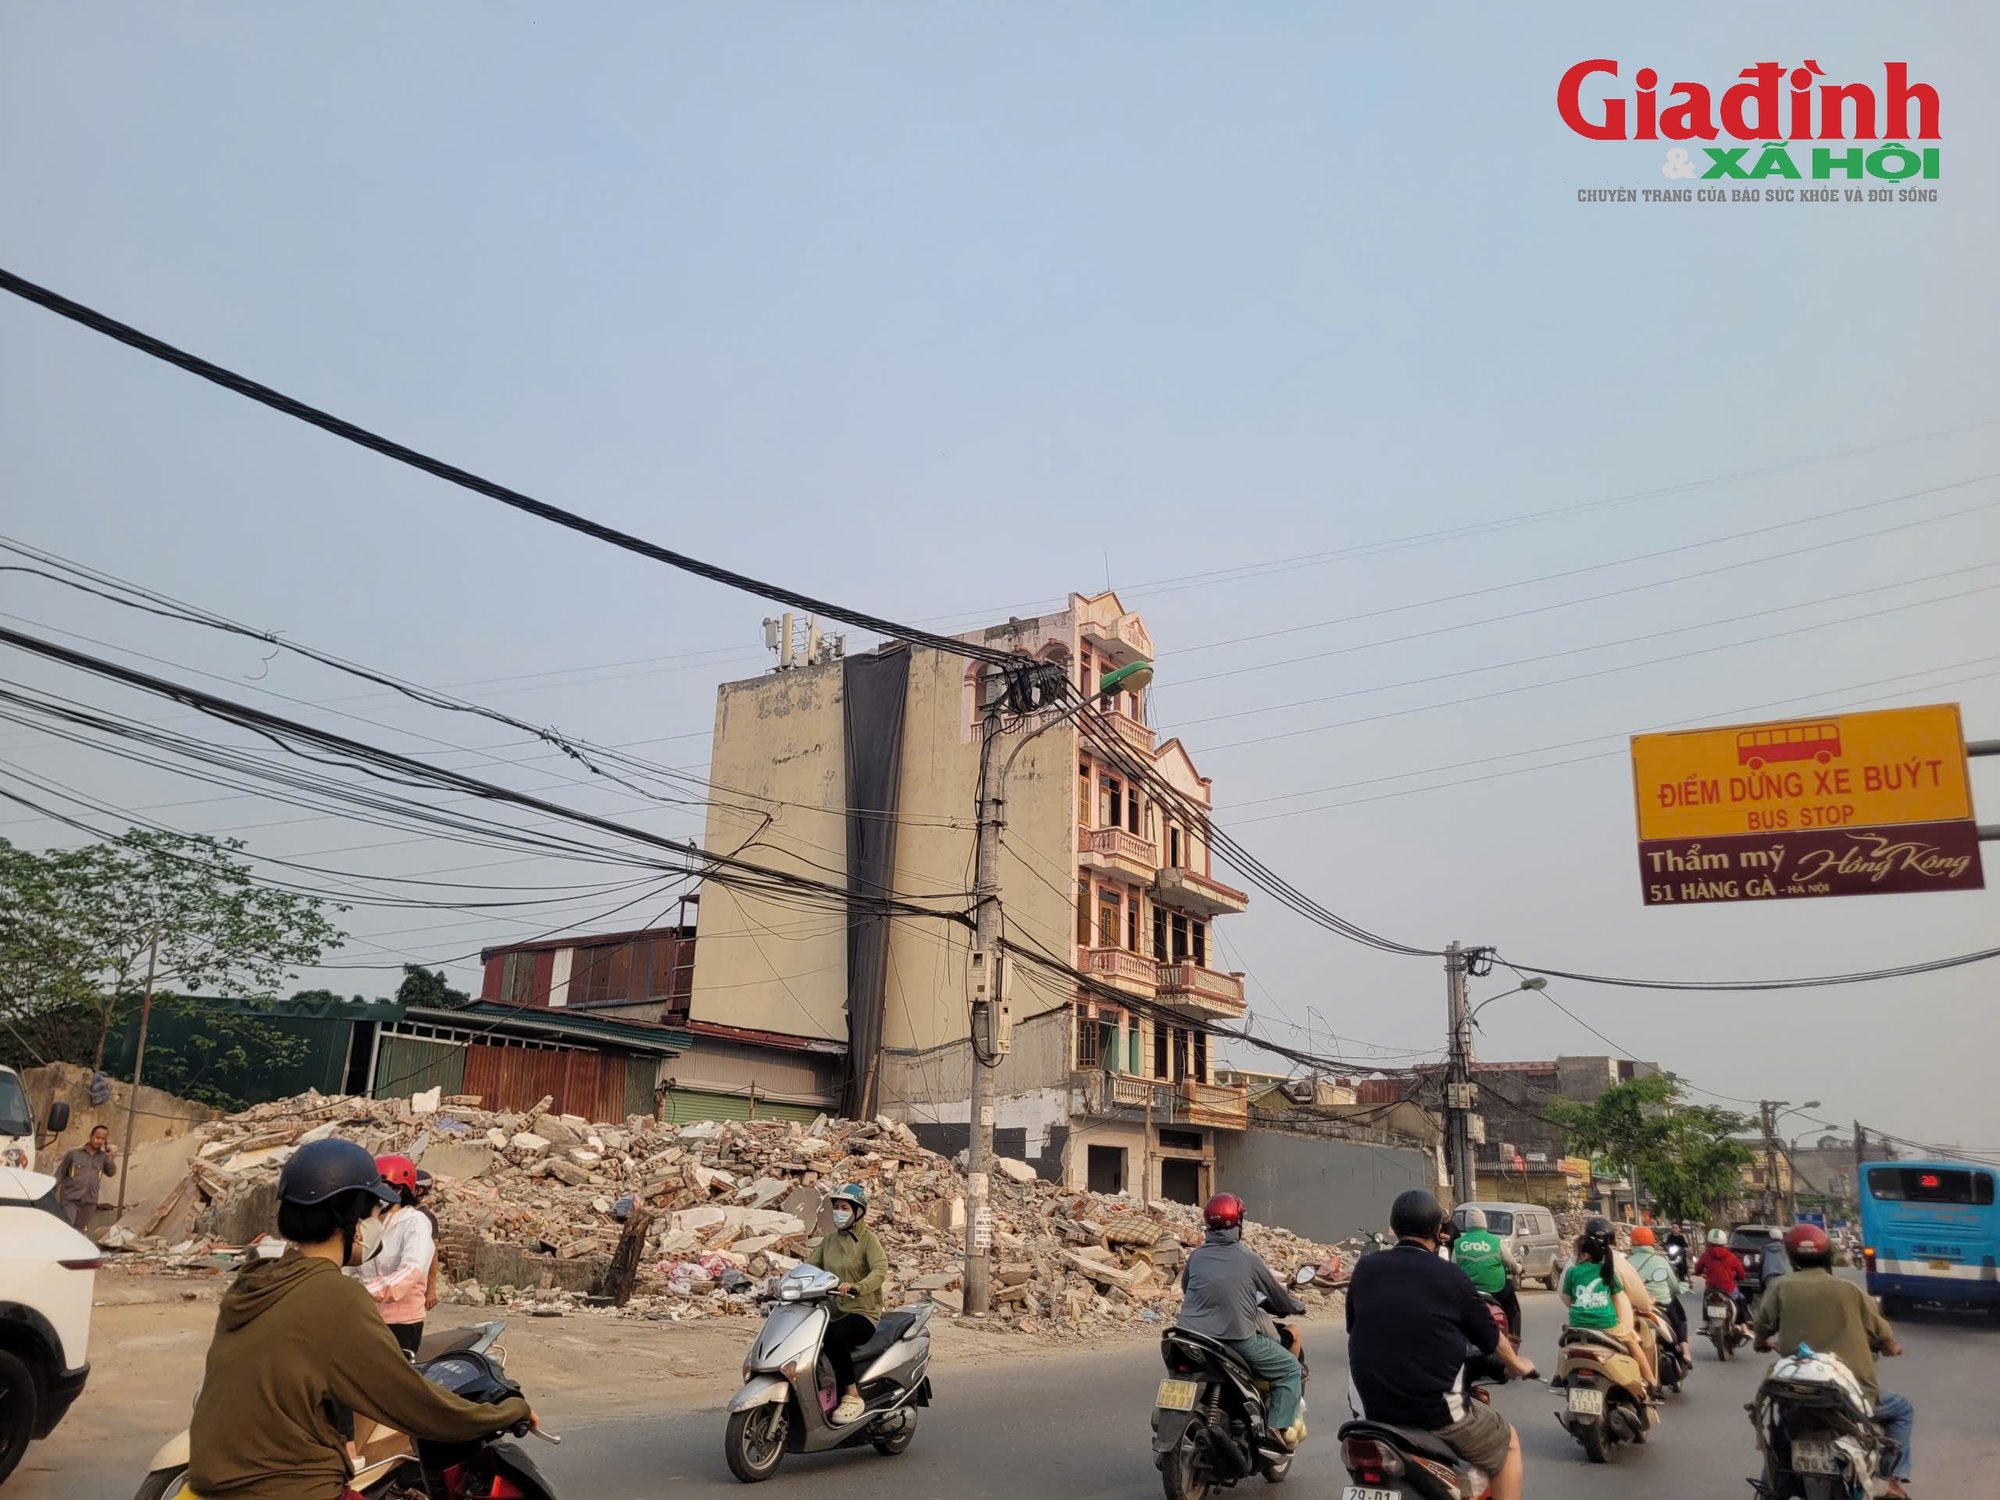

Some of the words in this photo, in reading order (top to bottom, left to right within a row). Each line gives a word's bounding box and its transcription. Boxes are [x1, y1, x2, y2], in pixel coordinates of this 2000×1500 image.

[1657, 773, 1721, 808] ĐIỂM
[1730, 772, 1802, 800] DỪNG
[1814, 768, 1851, 796] XE
[1864, 757, 1943, 791] BUÝT
[1747, 809, 1789, 830] BUS
[1800, 805, 1854, 827] STOP
[1647, 844, 1730, 873] Thẩm
[1740, 845, 1785, 872] mỹ
[1650, 884, 1675, 902] 51
[1681, 879, 1739, 900] HÀNG
[1745, 874, 1777, 897] GÀ
[1787, 884, 1804, 894] HÀ
[1808, 882, 1830, 895] NỘI
[1460, 1241, 1490, 1252] Grab
